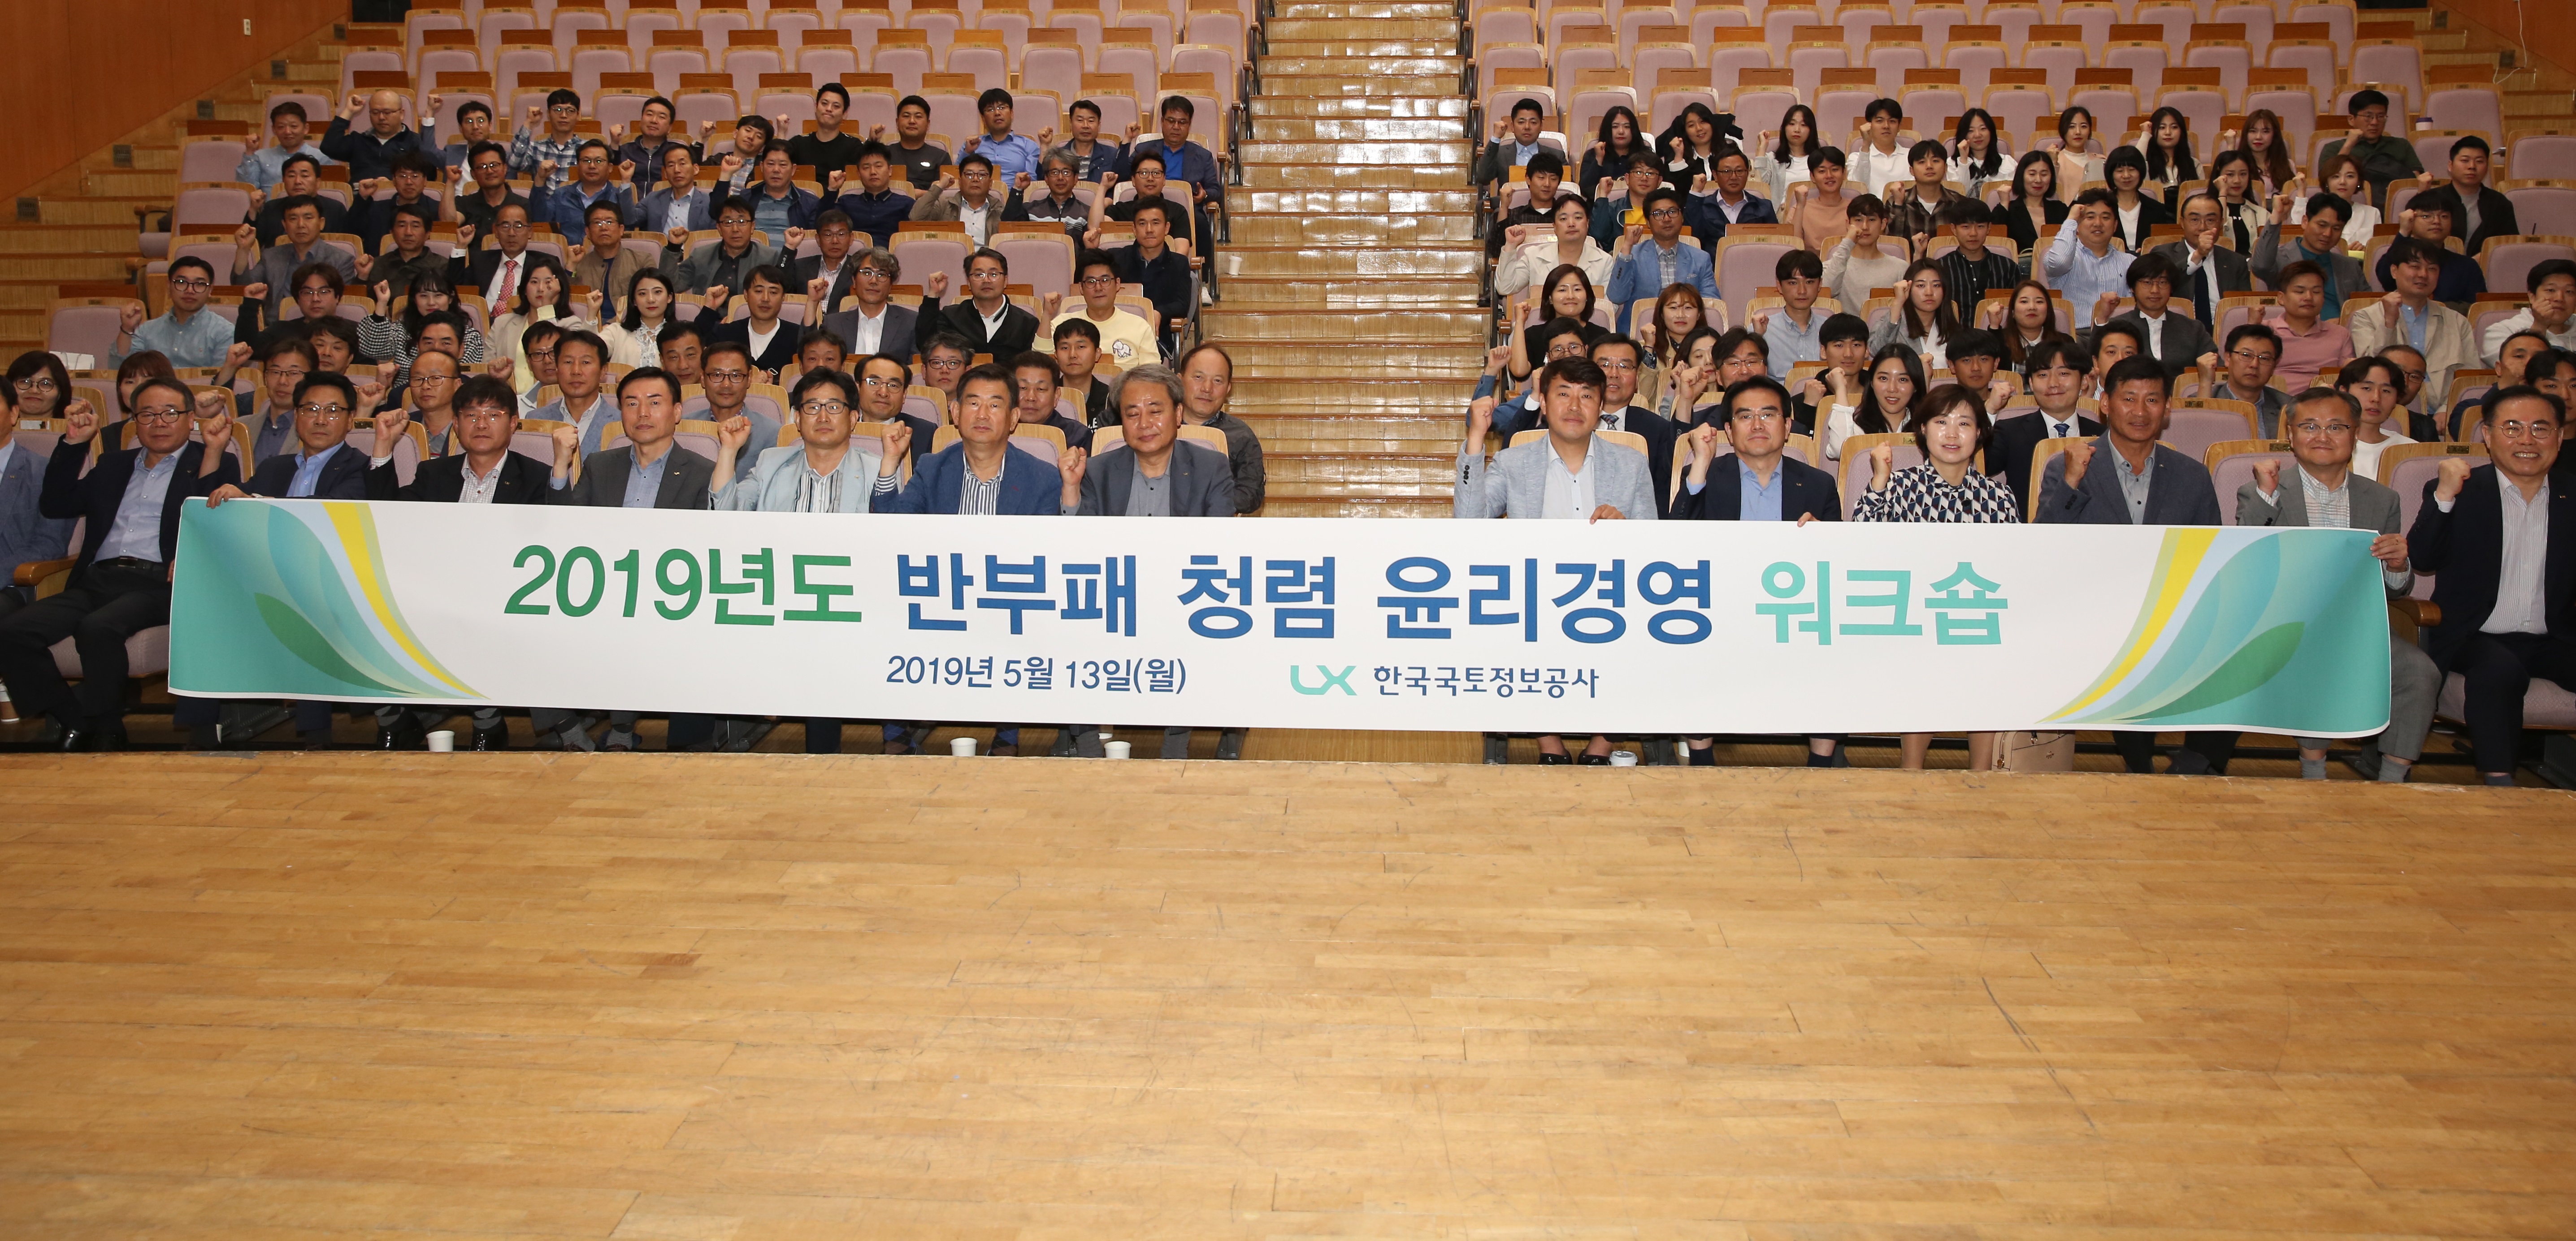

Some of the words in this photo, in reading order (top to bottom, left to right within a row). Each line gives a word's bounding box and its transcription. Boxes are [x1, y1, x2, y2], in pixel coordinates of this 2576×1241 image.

[504, 545, 862, 626] 2019년도
[897, 553, 1136, 637] 반부패
[1177, 555, 1335, 639] 청렴
[1377, 557, 1712, 645] 윤리경영
[1755, 561, 2008, 645] 워크숍
[886, 655, 993, 688] 2019년
[1003, 657, 1053, 690] 5월
[1066, 657, 1186, 694] 13일(월)
[1290, 665, 1357, 696] LX
[1374, 666, 1600, 699] 한국국토정보공사
